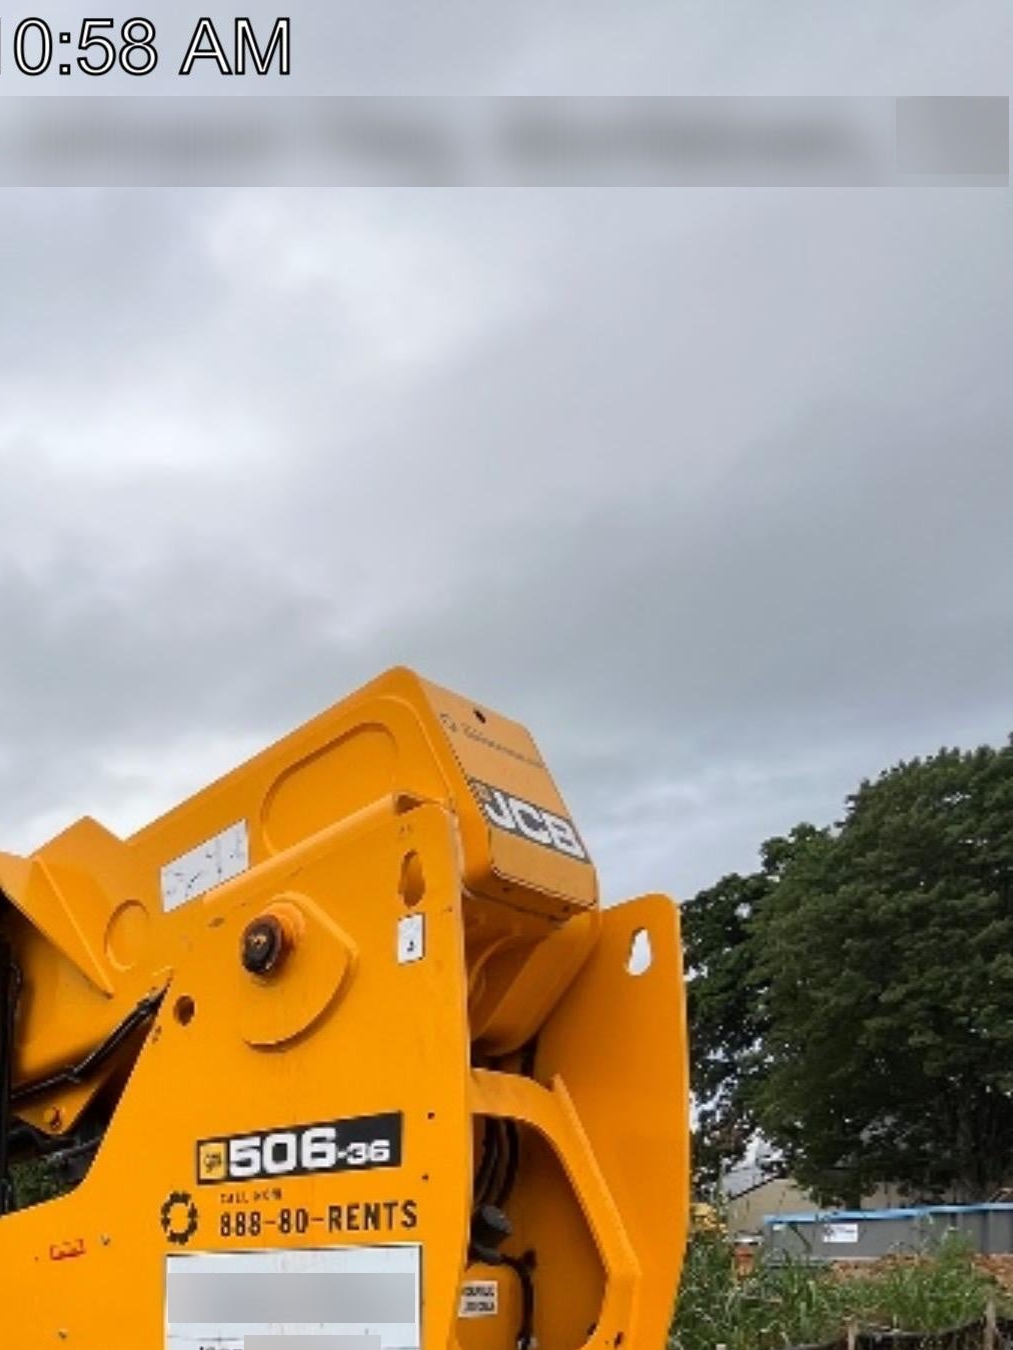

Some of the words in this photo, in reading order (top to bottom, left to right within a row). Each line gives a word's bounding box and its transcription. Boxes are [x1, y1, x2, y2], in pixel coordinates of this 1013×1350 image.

[482, 788, 588, 860] JCB
[229, 1126, 391, 1178] 506-36
[219, 1199, 418, 1238] 888-80-RENTS
